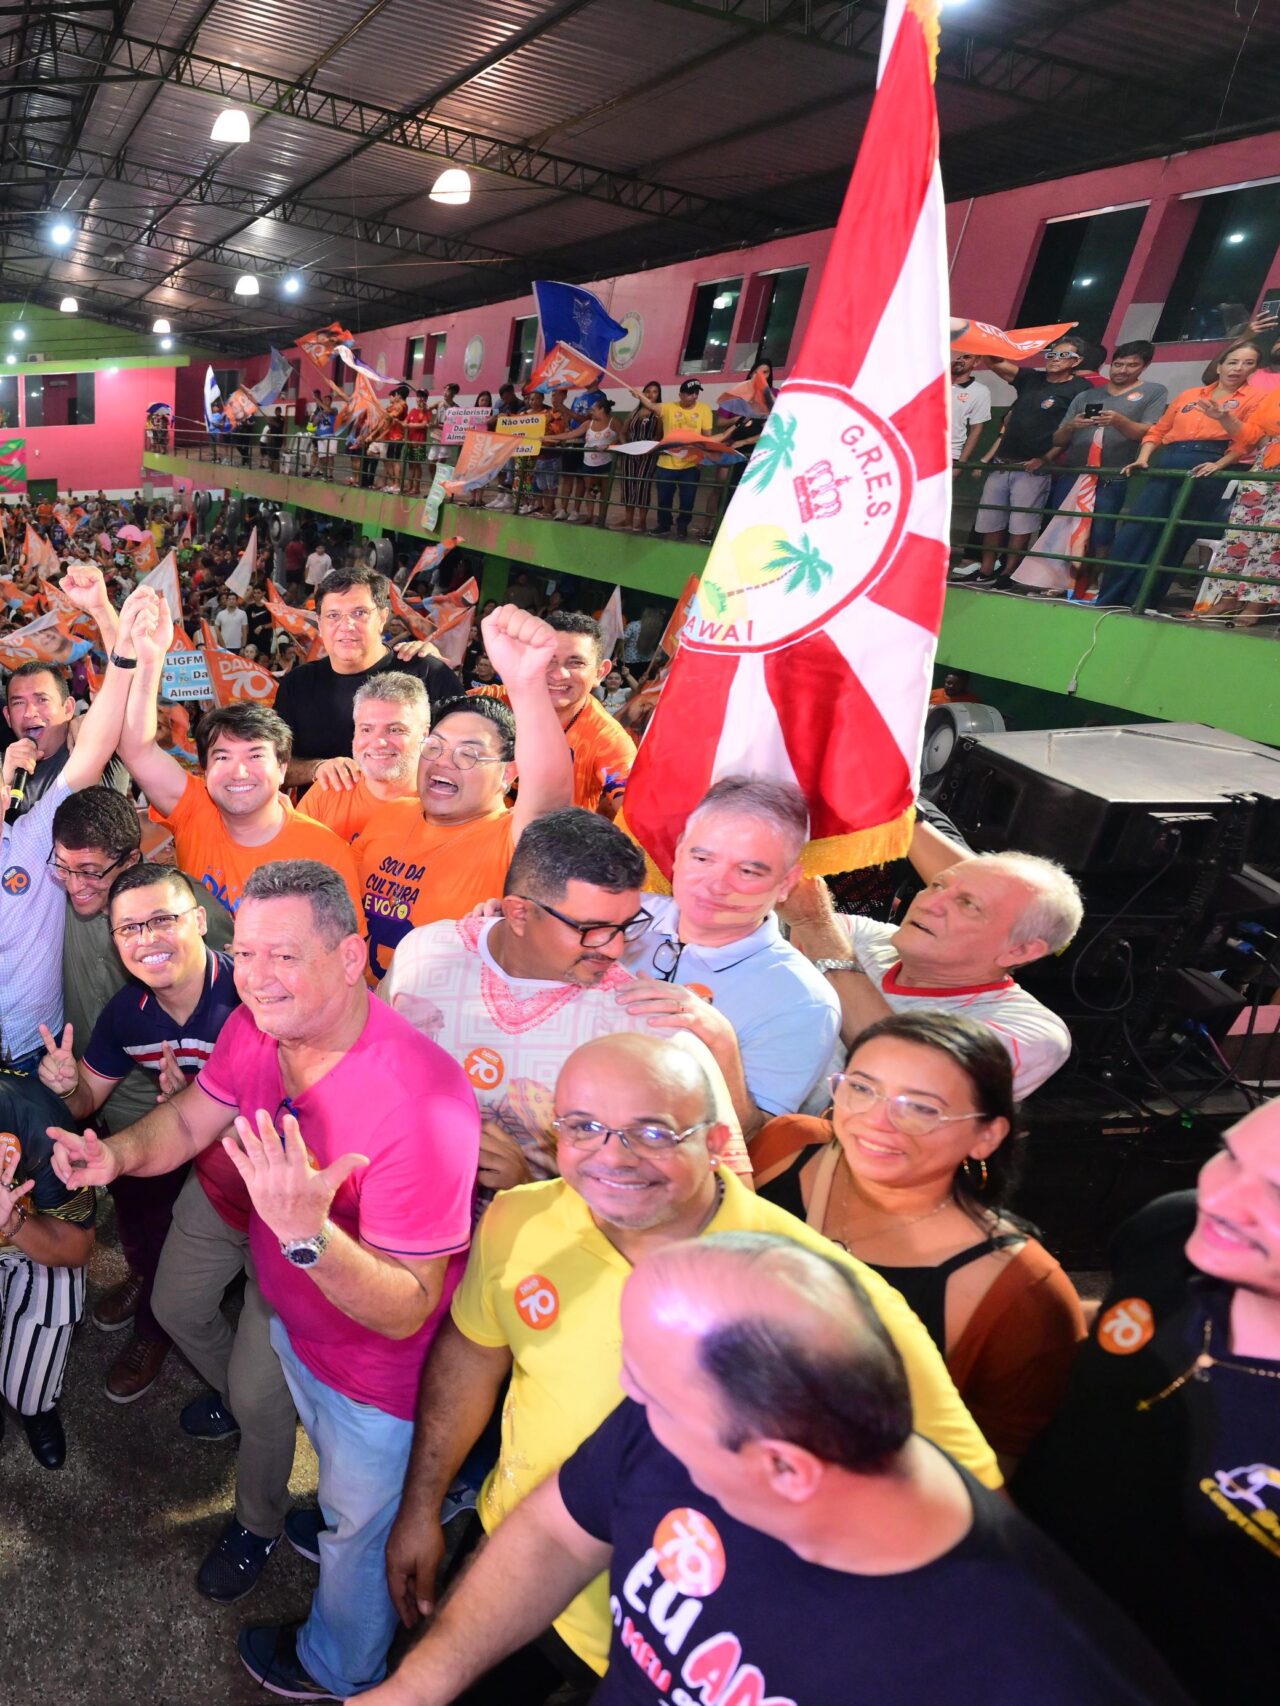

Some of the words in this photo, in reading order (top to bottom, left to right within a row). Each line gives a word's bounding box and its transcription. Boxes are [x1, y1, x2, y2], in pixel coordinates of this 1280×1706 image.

[447, 408, 490, 416] Folclorista
[501, 418, 518, 426] Não
[520, 417, 540, 425] voto
[841, 425, 892, 526] G.R.E.S.
[686, 616, 753, 642] AWAI
[166, 655, 203, 666] LIGFM
[170, 687, 214, 697] Almeid
[222, 671, 273, 698] 70
[379, 856, 405, 877] SOU
[405, 863, 426, 882] DA
[4, 873, 28, 893] 70
[365, 873, 420, 904] CULTURA
[469, 1055, 498, 1083] 70
[519, 1289, 554, 1323] 70
[1103, 1309, 1142, 1347] 70
